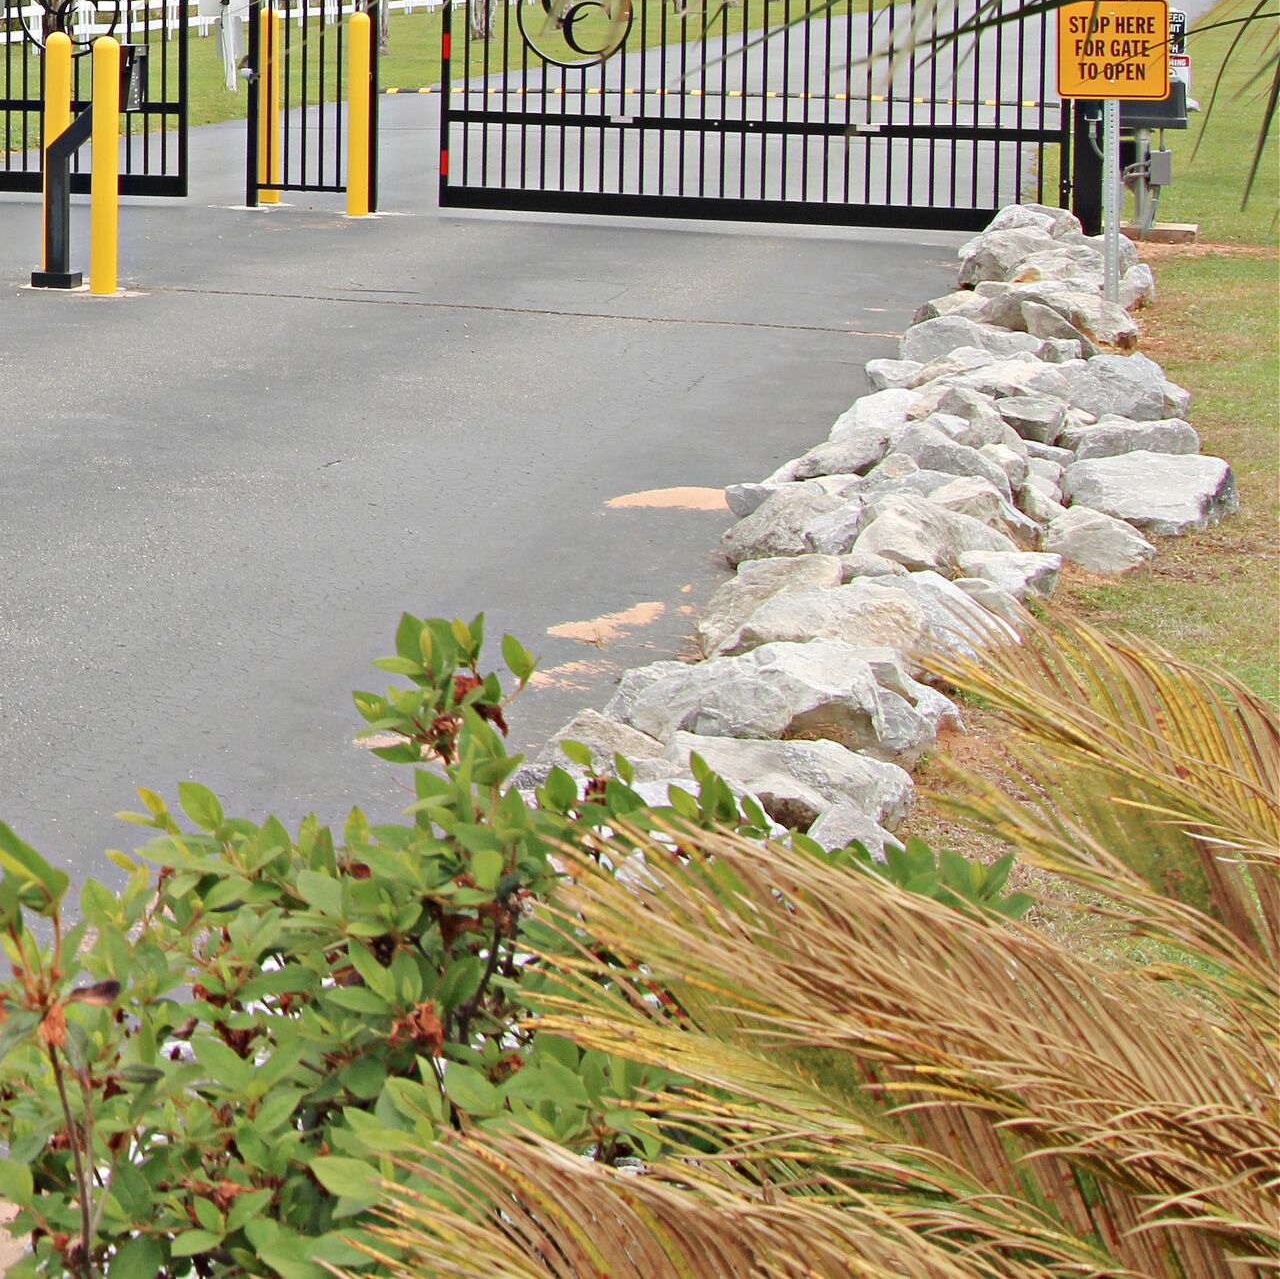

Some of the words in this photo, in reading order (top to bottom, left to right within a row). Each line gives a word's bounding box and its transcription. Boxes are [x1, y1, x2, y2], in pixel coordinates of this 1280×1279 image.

[1115, 16, 1155, 34] HERE
[1075, 39, 1105, 57] FOR
[1110, 39, 1151, 57] GATE
[1078, 63, 1098, 80] TO
[1104, 62, 1146, 80] OPEN
